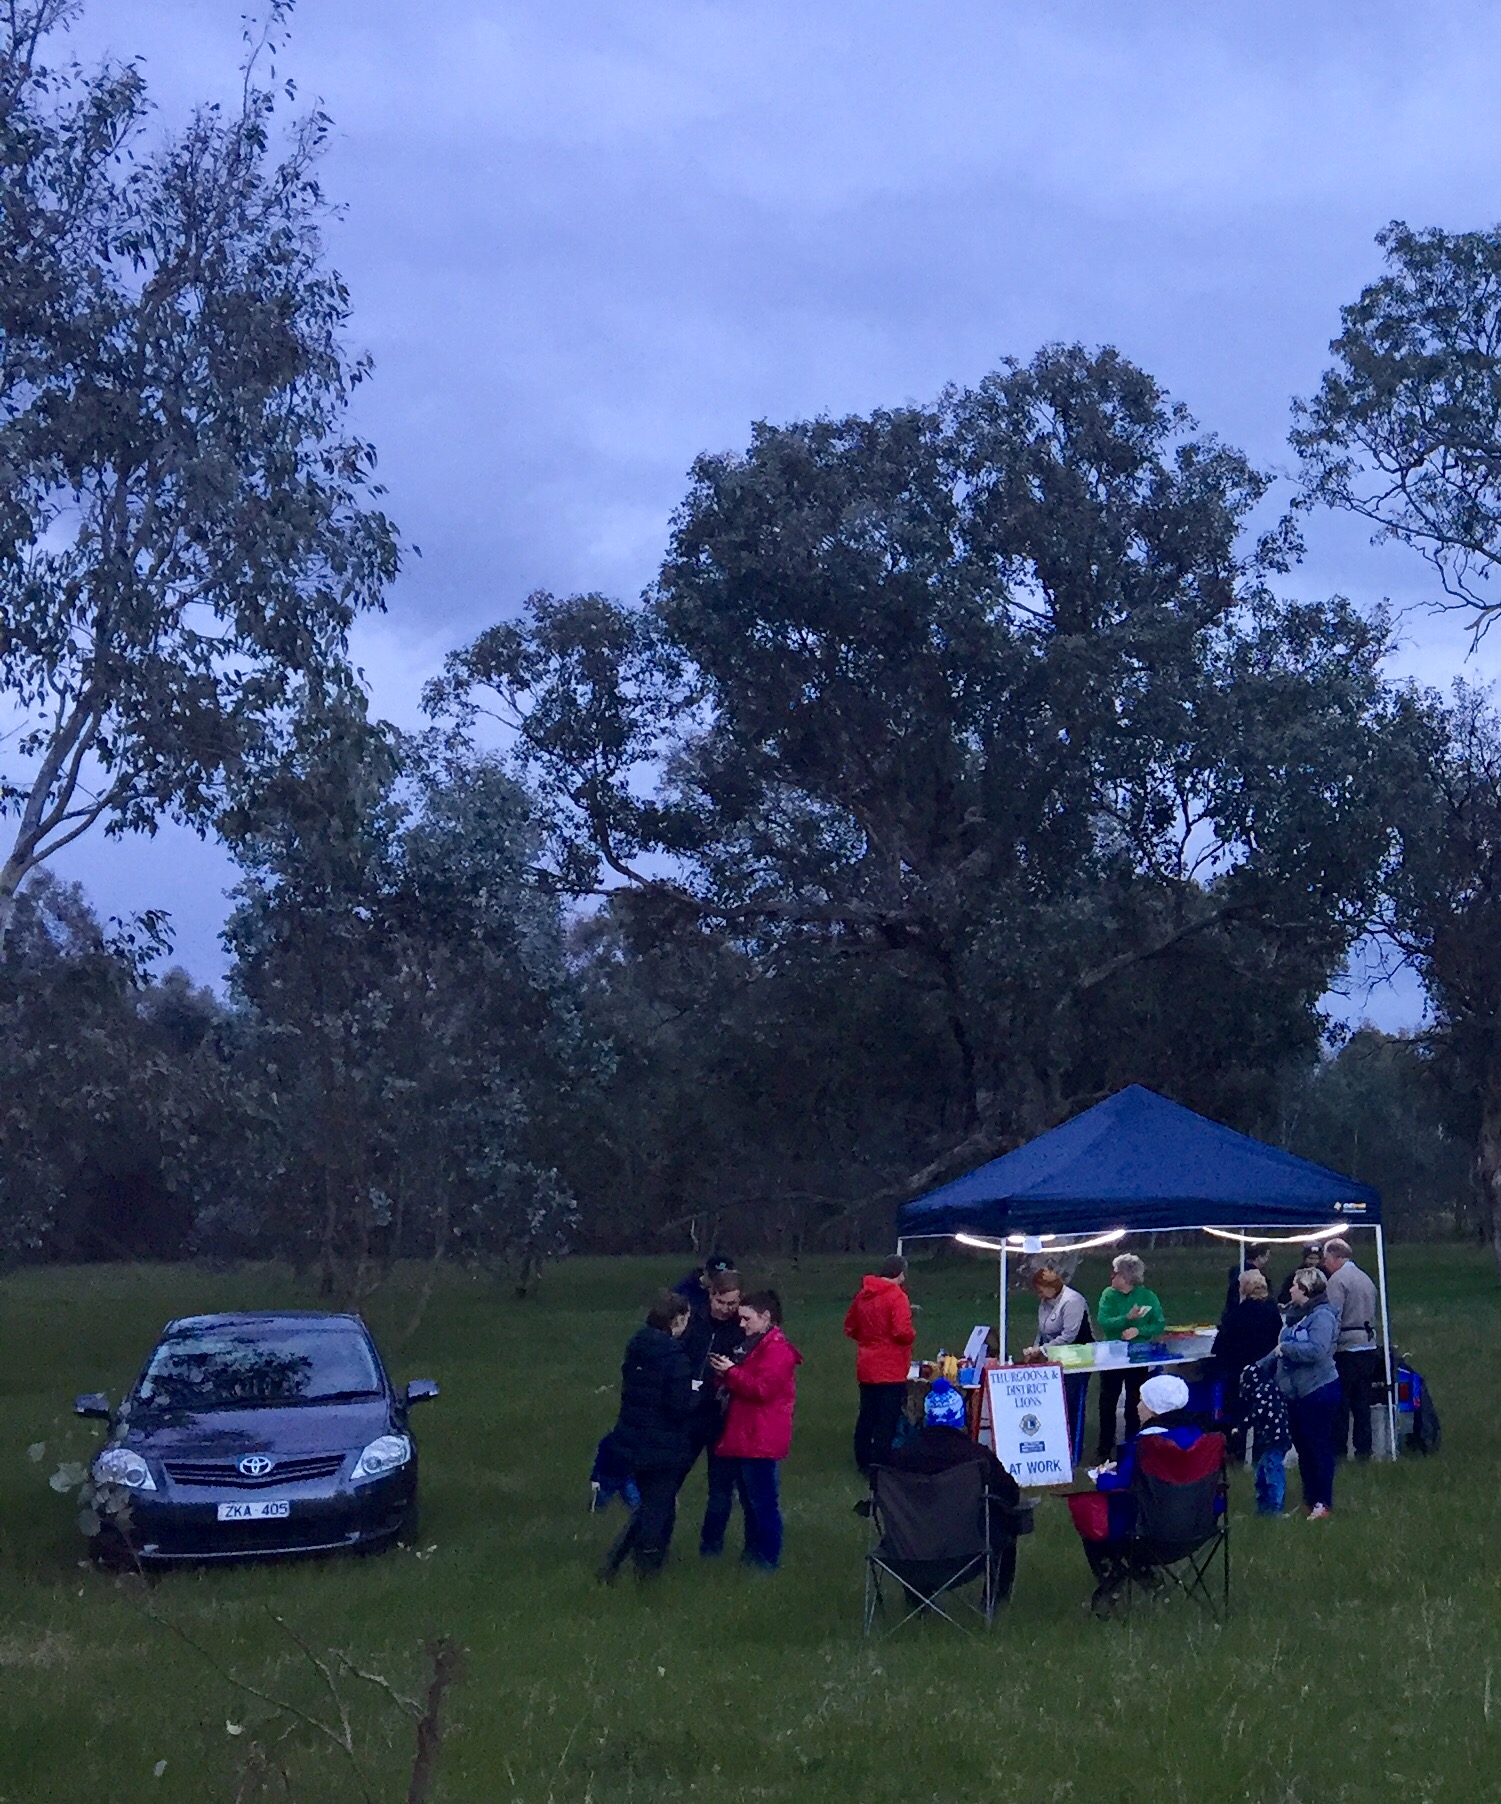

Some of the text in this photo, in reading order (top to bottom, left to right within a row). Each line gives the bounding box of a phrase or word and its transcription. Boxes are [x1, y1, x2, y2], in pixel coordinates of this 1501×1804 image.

[990, 1370, 1059, 1383] THURGOONA &
[1007, 1383, 1048, 1396] DISTRICT
[1015, 1396, 1042, 1408] LIONS
[1009, 1460, 1062, 1475] AT WORK
[225, 1503, 288, 1518] ZKA 405
